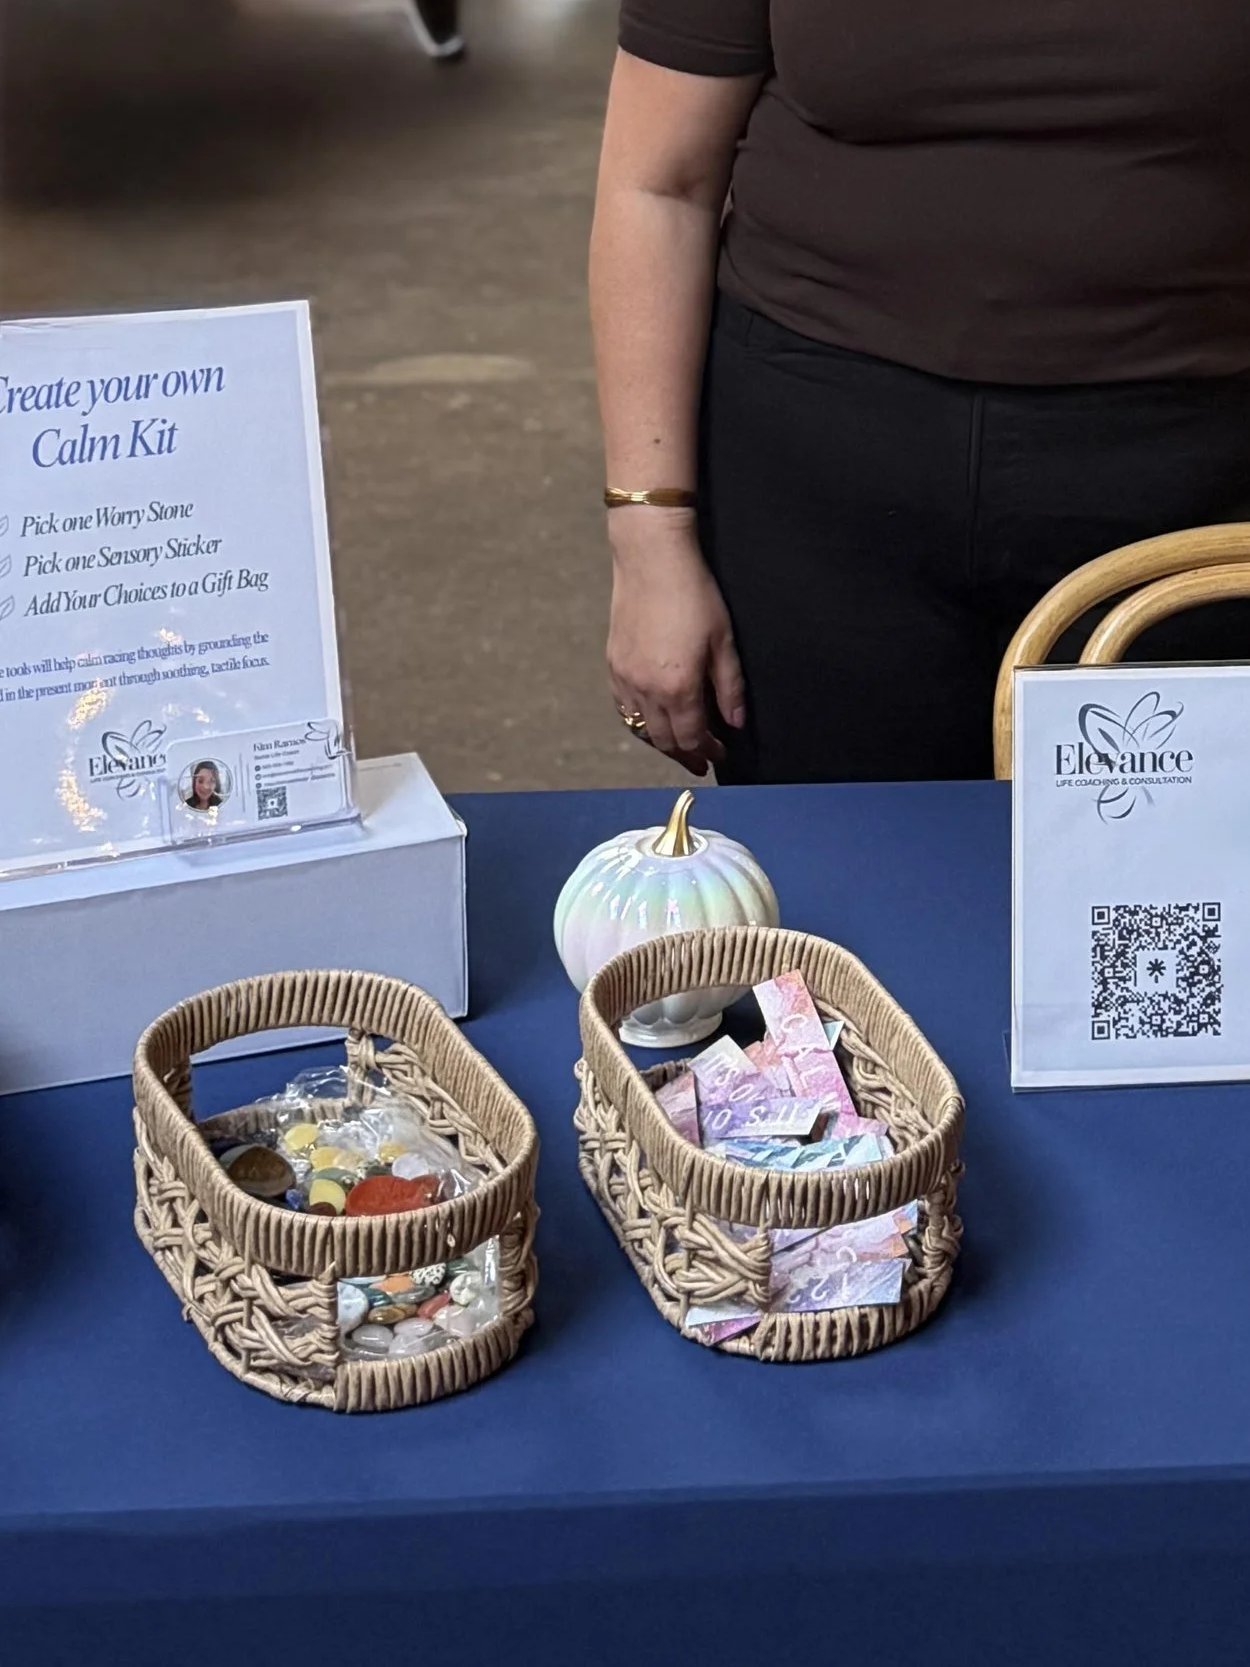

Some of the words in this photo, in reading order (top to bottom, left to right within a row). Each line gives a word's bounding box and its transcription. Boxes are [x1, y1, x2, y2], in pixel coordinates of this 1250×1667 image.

[82, 373, 158, 416] your
[162, 366, 225, 397] own
[32, 423, 121, 468] Calm
[126, 418, 179, 458] Kit
[20, 512, 59, 537] Pick
[62, 514, 93, 532] one
[95, 506, 145, 529] Worry
[146, 501, 194, 522] Stone
[23, 552, 61, 577] Pick
[65, 554, 96, 572] one
[97, 545, 163, 567] Sensory
[165, 534, 222, 559] Sticker
[23, 591, 60, 617] Add
[63, 590, 102, 612] Your
[103, 583, 167, 607] Choices
[171, 581, 186, 598] to
[188, 580, 199, 595] a
[201, 570, 234, 597] Gift
[237, 568, 269, 592] Bag
[33, 659, 52, 673] will
[53, 657, 76, 673] help
[103, 650, 136, 664] racing
[183, 640, 195, 655] by
[198, 634, 252, 655] grounding
[253, 631, 269, 644] the
[17, 686, 34, 700] the
[35, 682, 72, 701] present
[119, 665, 160, 686] through
[211, 657, 241, 673] tactile
[1054, 742, 1194, 775] Elevance
[1056, 778, 1074, 787] LIFE
[1075, 777, 1120, 787] COACHING
[1129, 776, 1192, 785] CONSULTATION
